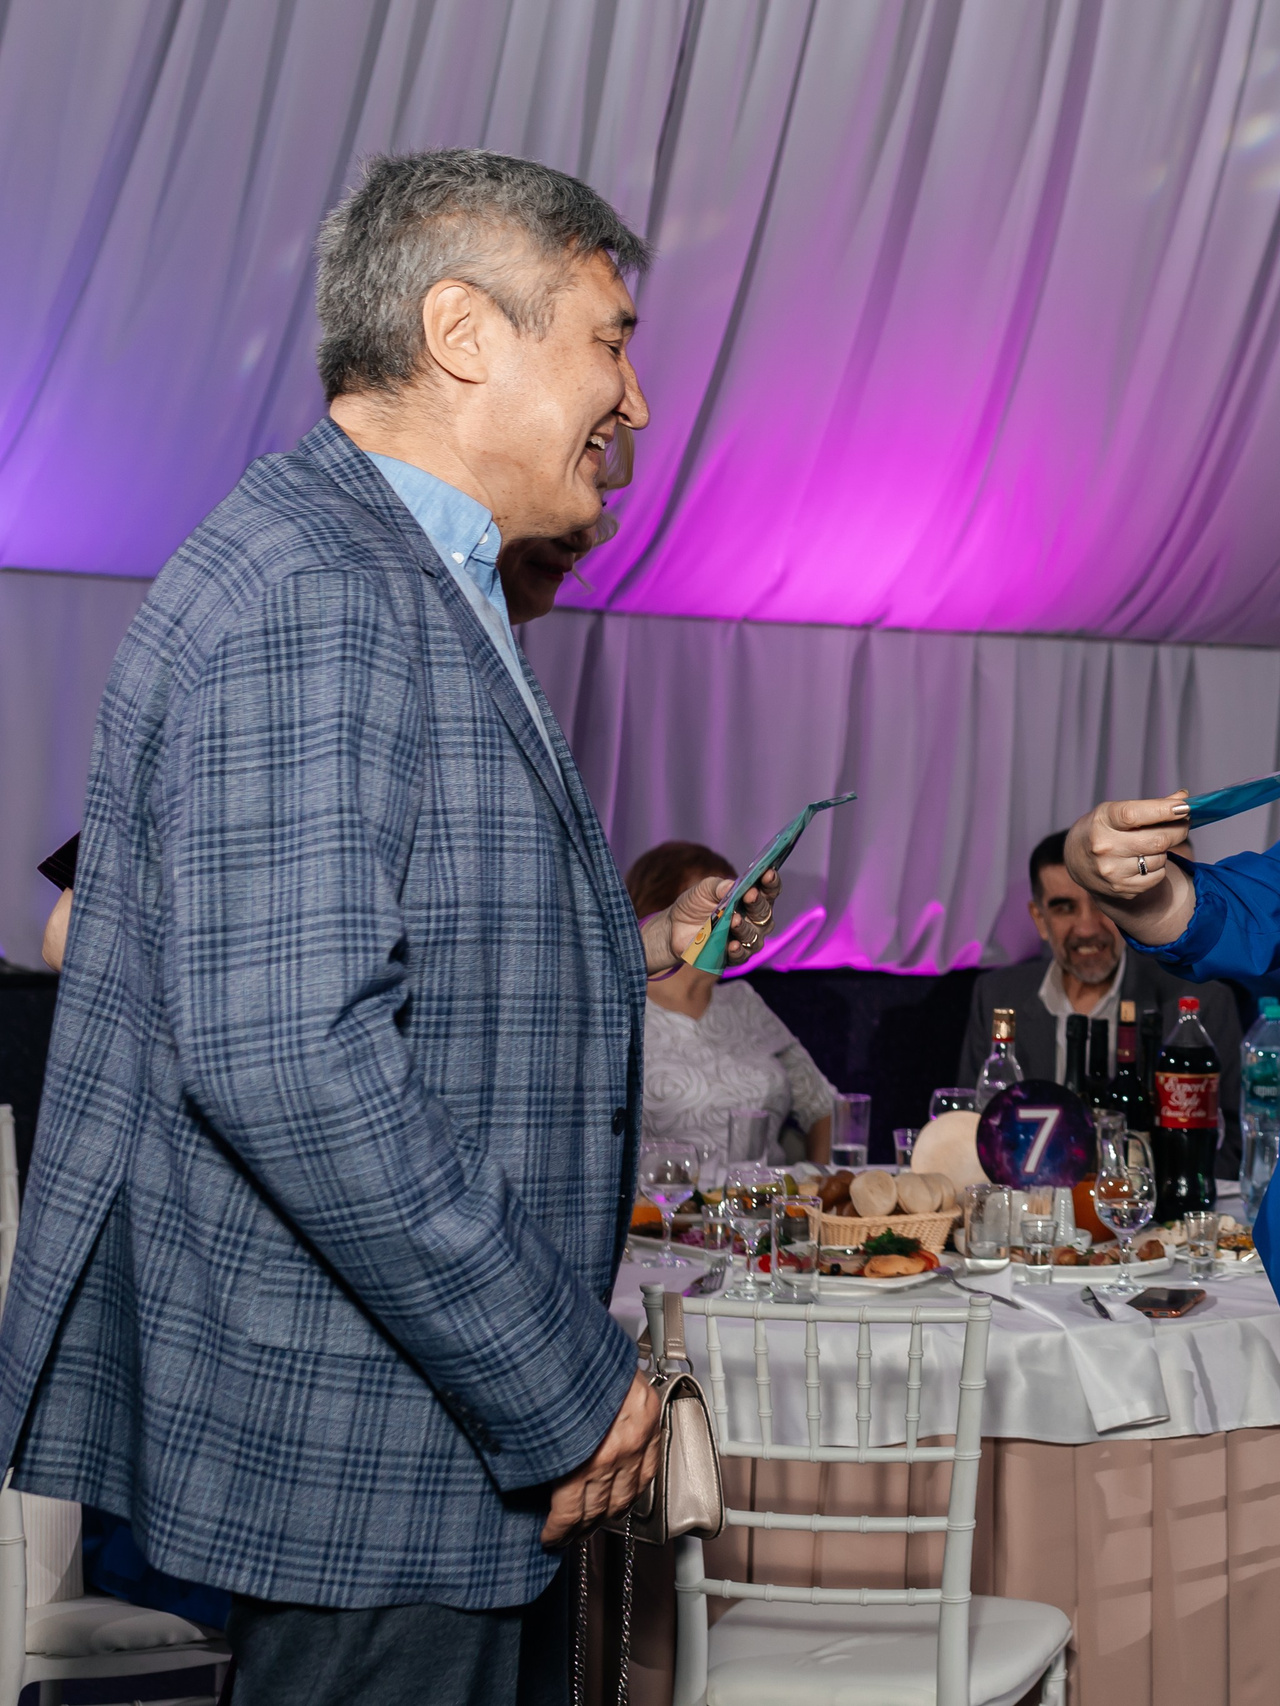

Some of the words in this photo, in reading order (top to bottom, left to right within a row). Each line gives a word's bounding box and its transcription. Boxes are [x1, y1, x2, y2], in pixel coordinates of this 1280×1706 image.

[1164, 1077, 1208, 1092] Export
[1168, 1091, 1200, 1110] Style
[1018, 1108, 1061, 1173] 7
